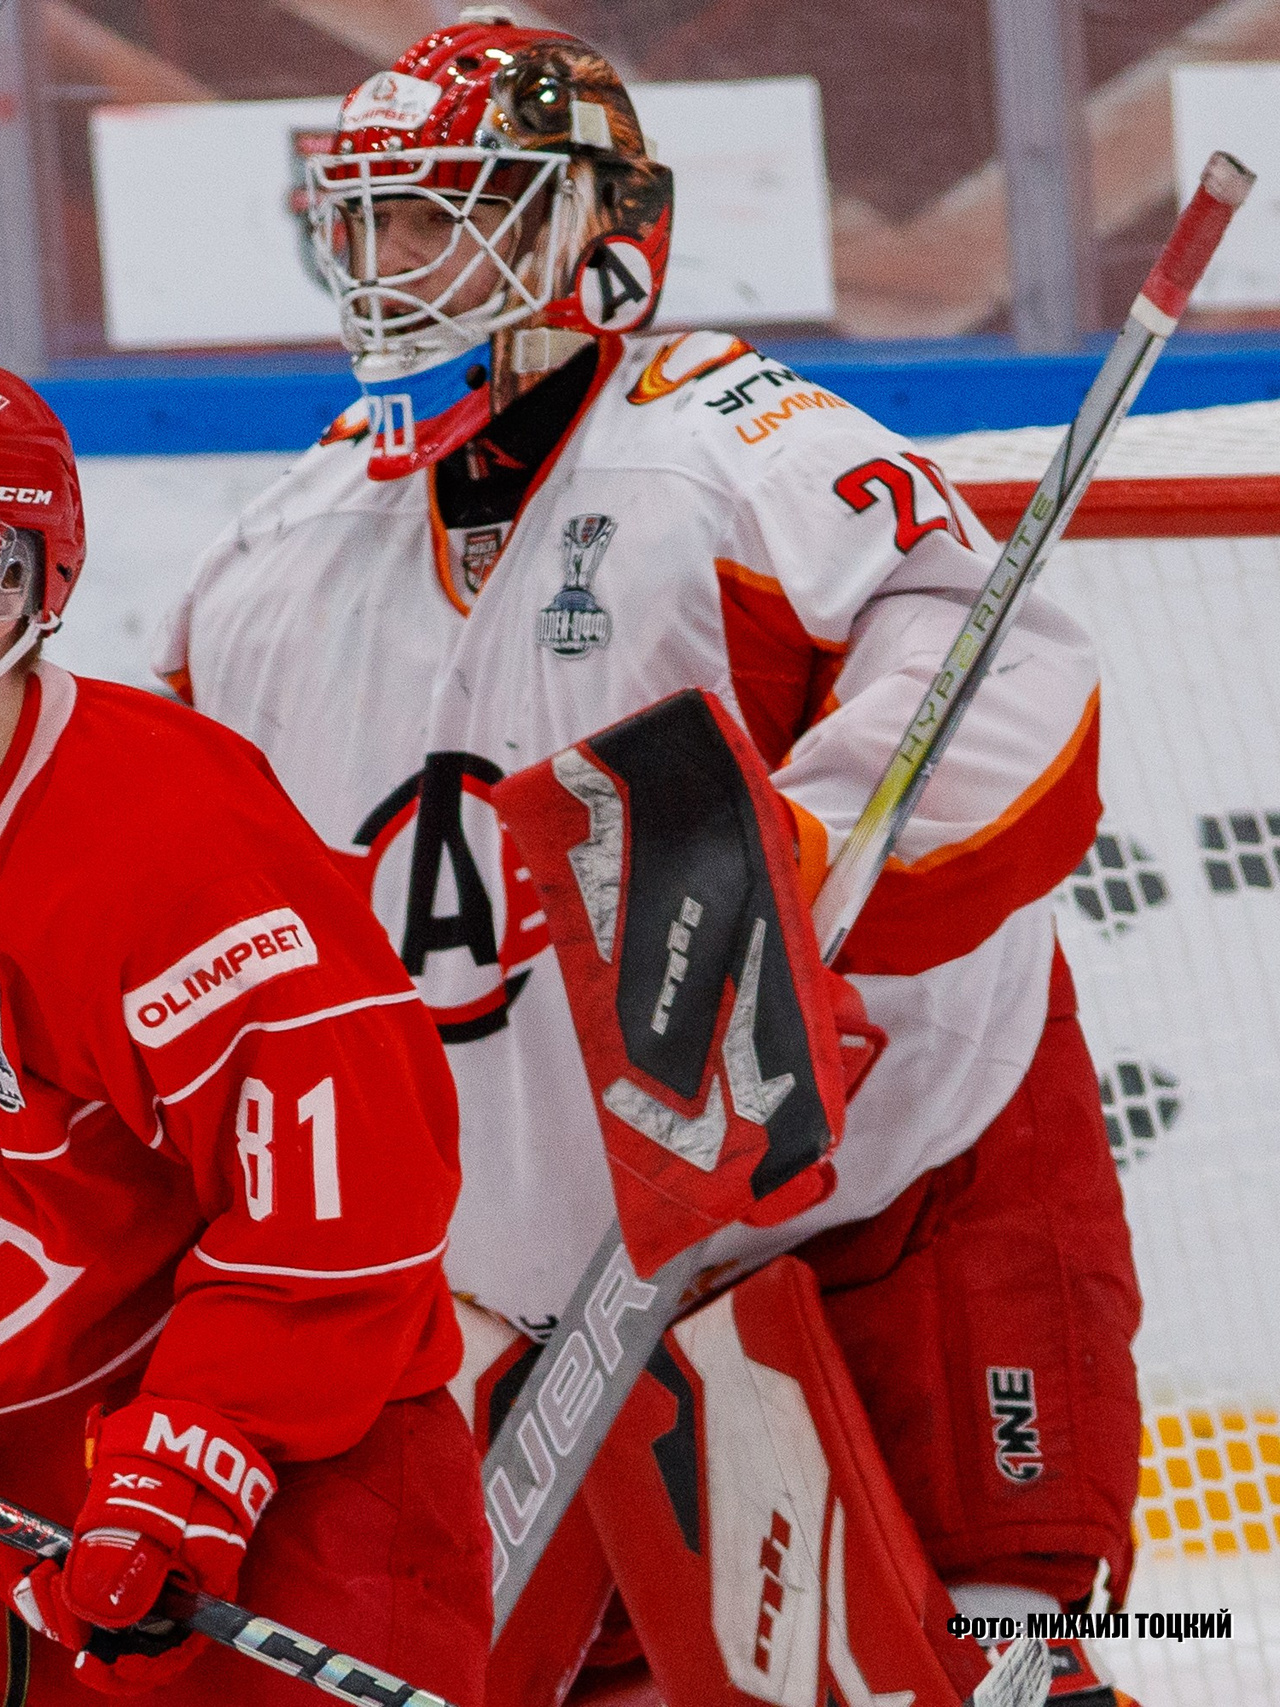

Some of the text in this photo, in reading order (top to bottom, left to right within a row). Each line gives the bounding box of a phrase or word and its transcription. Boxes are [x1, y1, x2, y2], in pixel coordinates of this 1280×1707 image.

[704, 367, 813, 416] УГМ
[137, 923, 304, 1029] OLIMPBET
[235, 1075, 342, 1222] 81
[109, 1471, 163, 1490] XF
[233, 1616, 459, 1707] CC
